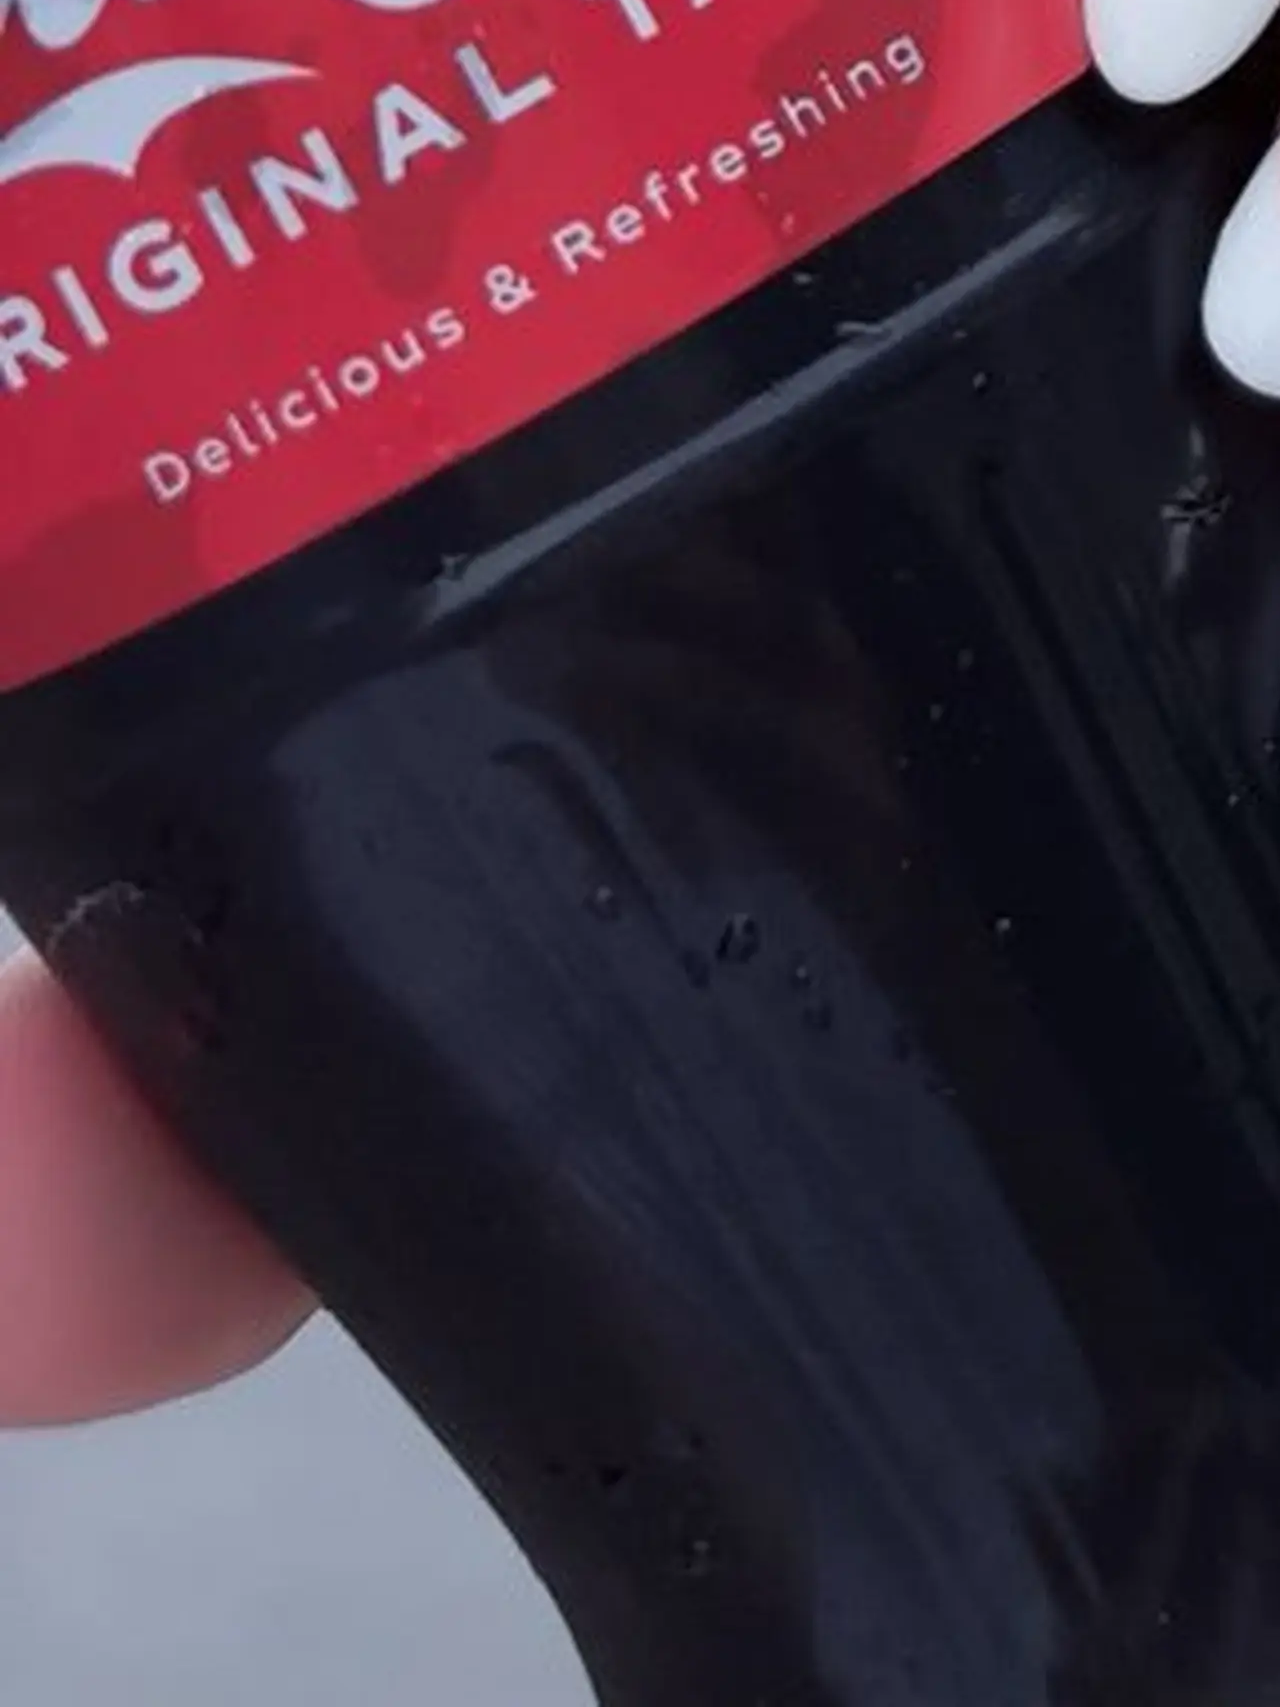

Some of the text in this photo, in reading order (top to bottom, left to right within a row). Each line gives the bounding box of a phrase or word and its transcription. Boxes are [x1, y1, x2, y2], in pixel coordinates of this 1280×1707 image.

[143, 33, 926, 502] Delicious & Refreshing
